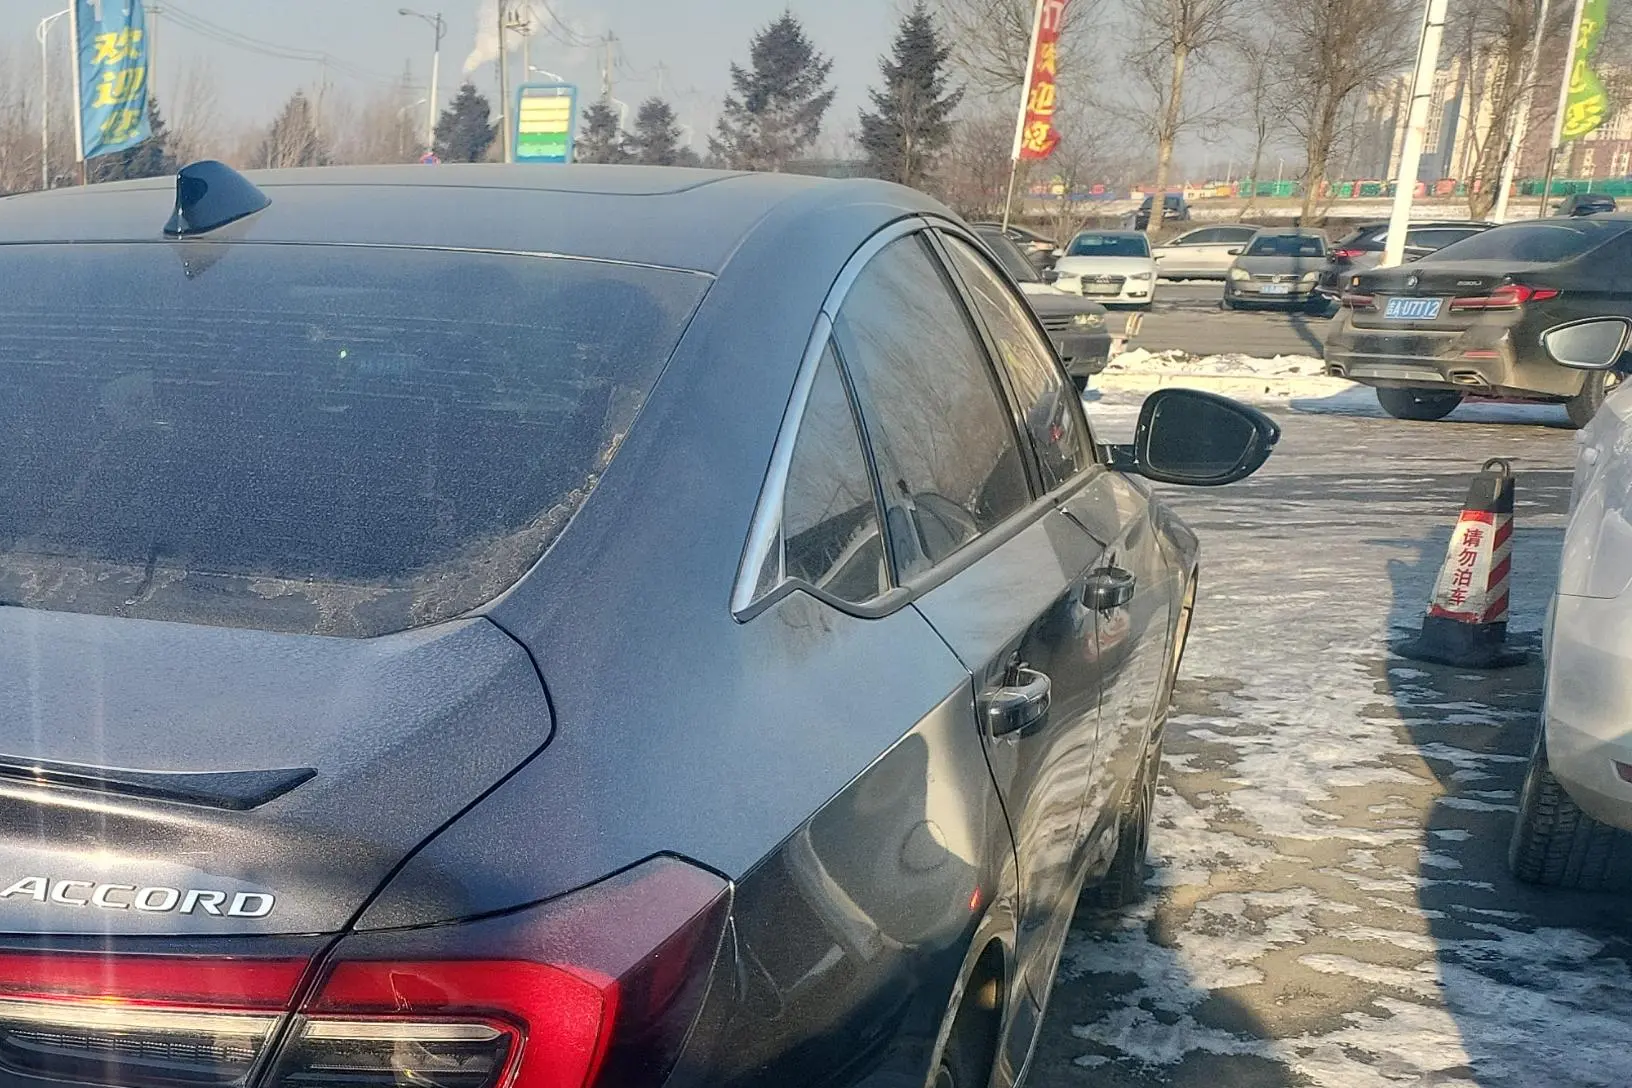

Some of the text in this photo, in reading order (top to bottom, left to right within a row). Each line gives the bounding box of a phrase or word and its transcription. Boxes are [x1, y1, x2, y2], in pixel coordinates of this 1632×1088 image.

[90, 26, 146, 145] 欢迎您
[1449, 528, 1484, 606] 请勿泊车
